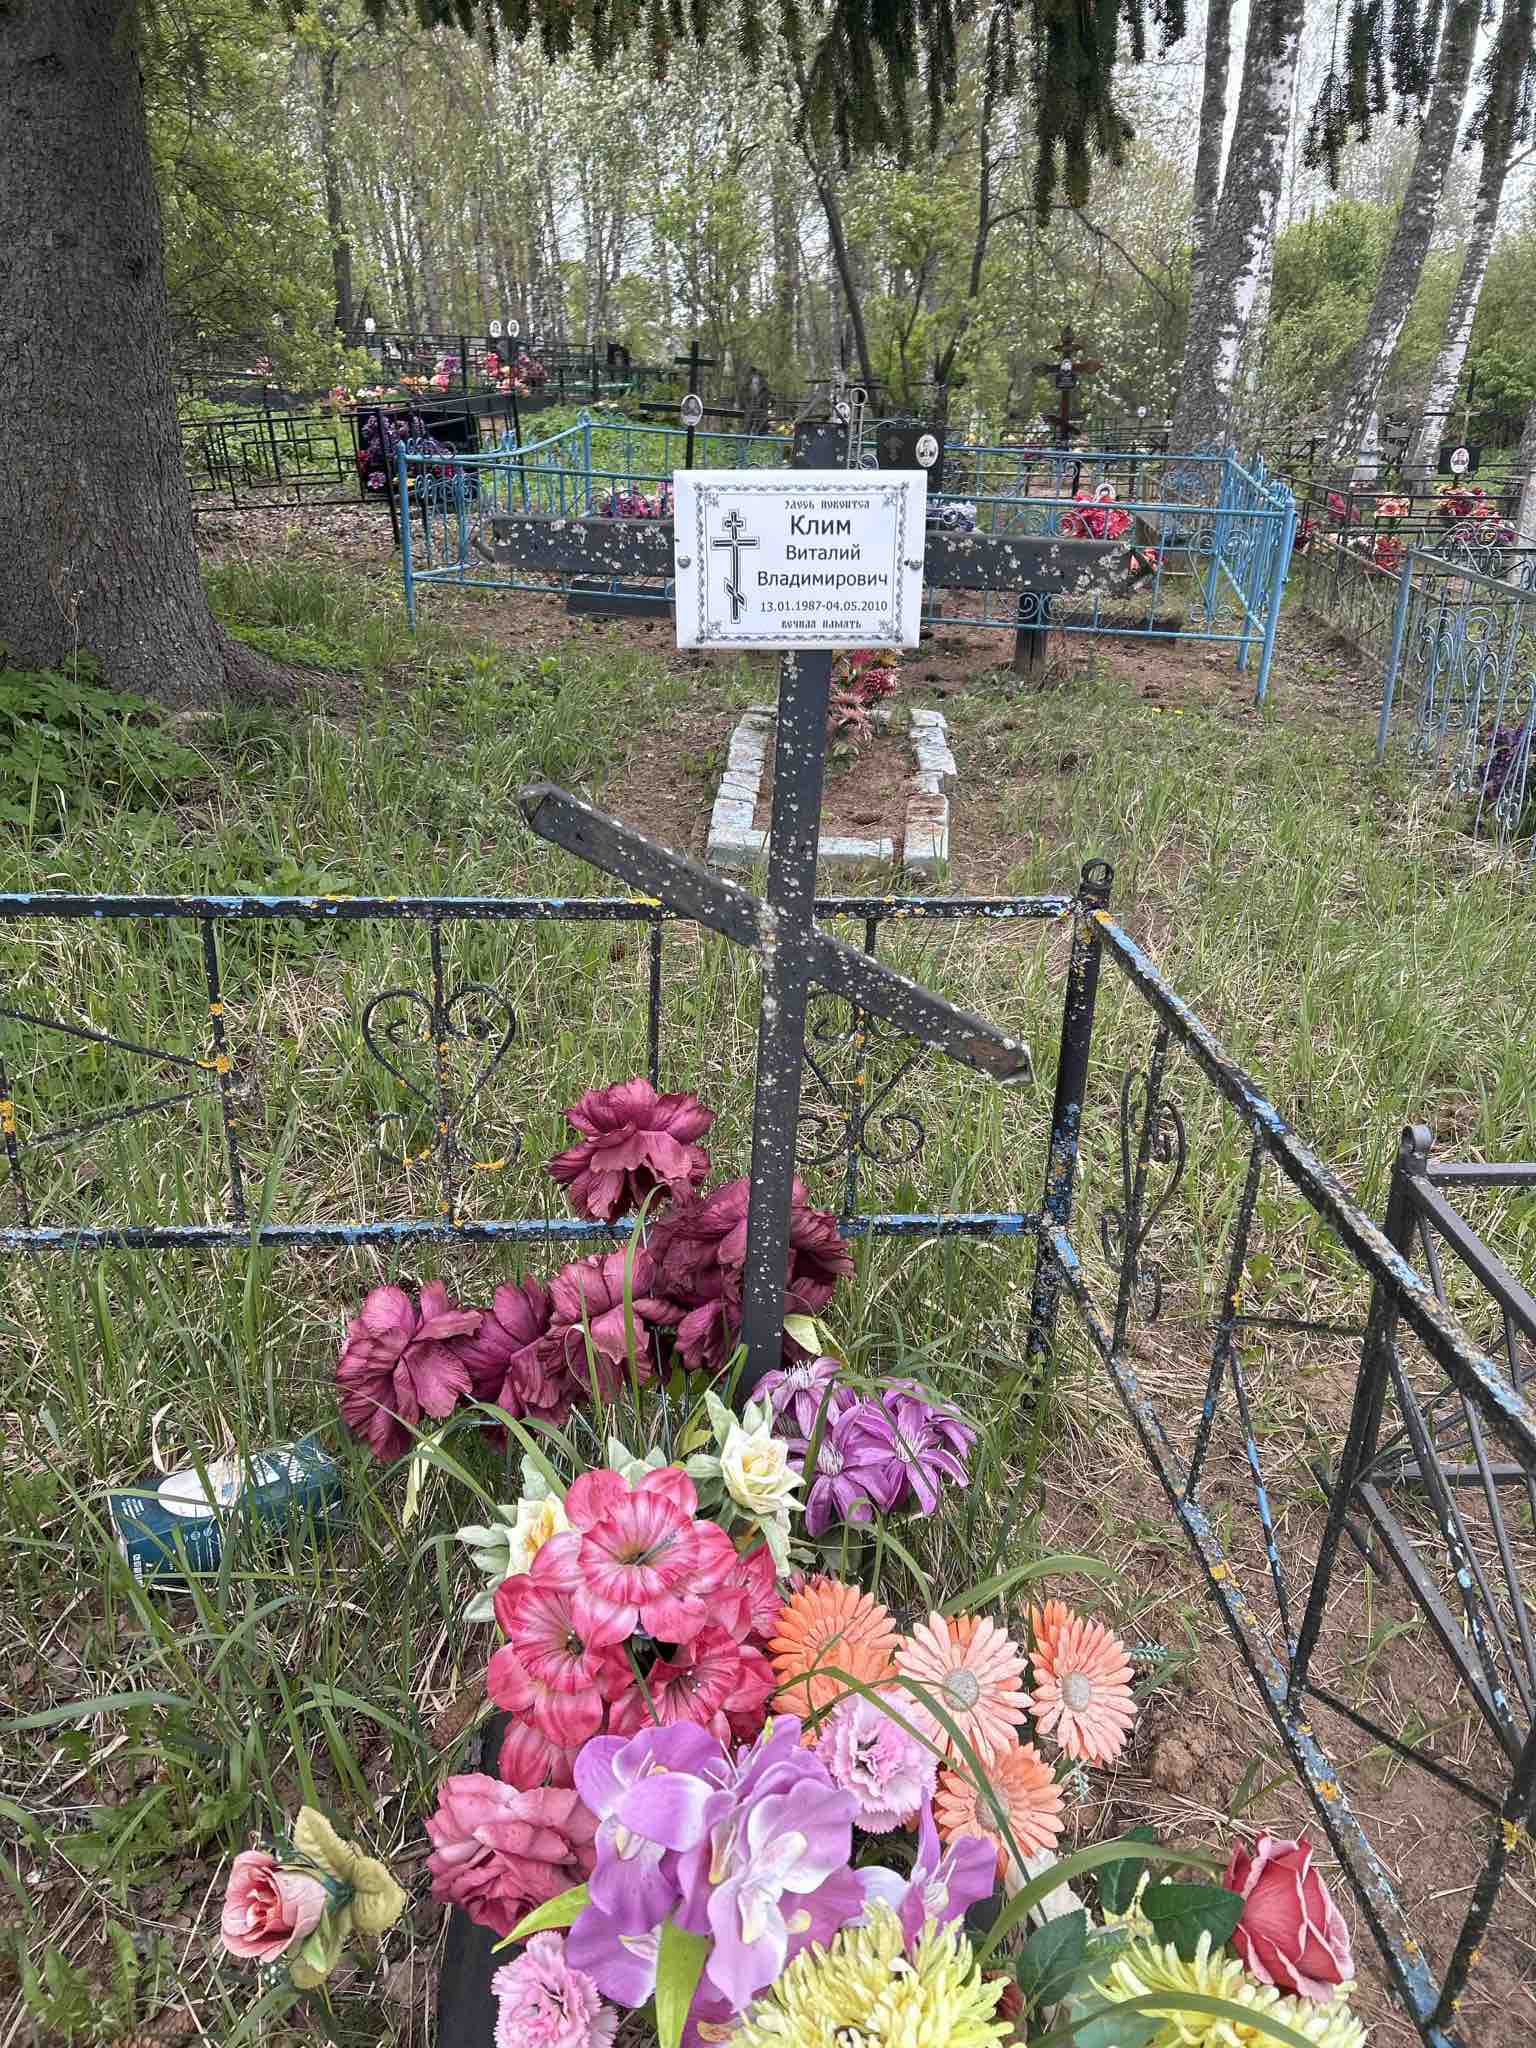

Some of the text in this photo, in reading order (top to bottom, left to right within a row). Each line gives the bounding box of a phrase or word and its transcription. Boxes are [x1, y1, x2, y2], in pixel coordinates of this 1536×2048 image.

[790, 515, 851, 535] Клим
[786, 544, 861, 561] Виталий
[757, 570, 888, 592] Владимирович
[760, 600, 888, 613] 13.01.1987-04.05.2010
